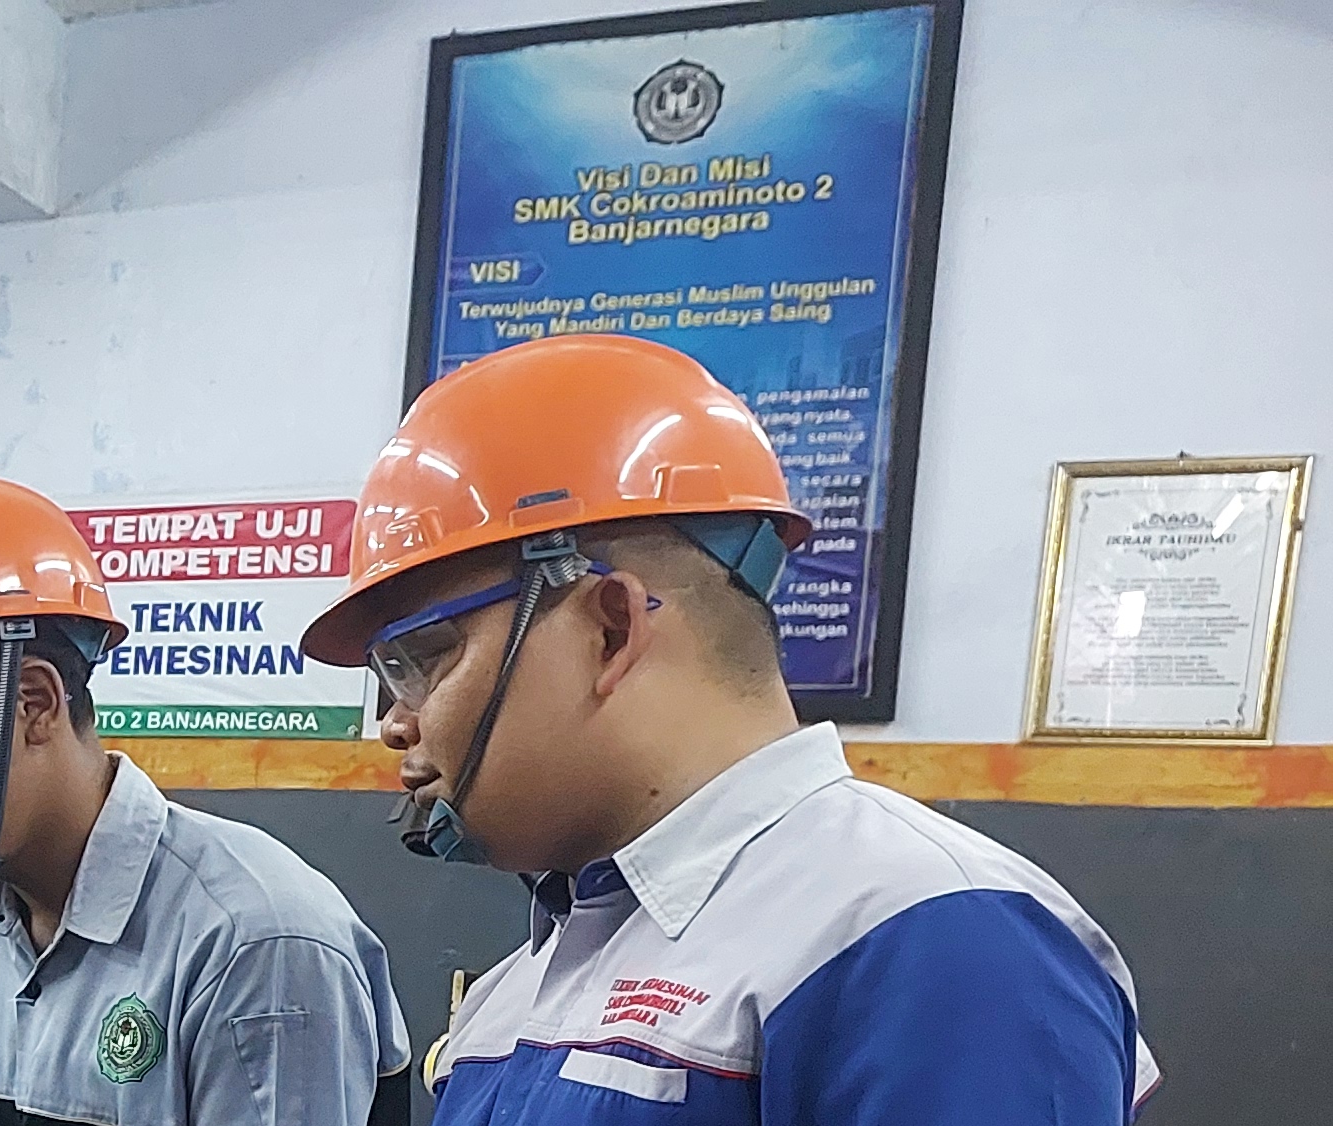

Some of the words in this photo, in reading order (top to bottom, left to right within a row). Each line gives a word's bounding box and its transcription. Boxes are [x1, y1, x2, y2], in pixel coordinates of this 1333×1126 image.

[577, 165, 631, 192] Visi
[639, 163, 698, 187] Dan
[708, 155, 770, 182] Misi
[514, 195, 582, 223] SMK
[590, 180, 805, 217] Cokroaminoto
[814, 175, 833, 200] 2
[568, 210, 770, 244] Banjarnegara
[470, 260, 521, 283] VISI
[459, 296, 585, 321] Terwujudnya
[590, 290, 682, 310] Generasi
[688, 282, 763, 304] Muslim
[770, 276, 875, 301] Unggulan
[495, 320, 544, 340] Yang
[549, 314, 625, 335] Mandiri
[630, 312, 670, 330] Dan
[677, 306, 764, 330] Berdaya
[770, 302, 832, 324] Saing
[88, 511, 244, 545] TEMPAT
[255, 508, 323, 539] UJI
[92, 543, 333, 578] OMPETENSI
[812, 536, 857, 554] pada
[787, 579, 852, 597] rangka
[131, 600, 264, 633] TEKNIK
[99, 645, 305, 676] EMESINAN
[130, 711, 142, 730] 2
[147, 711, 319, 731] BANJARNEGARA
